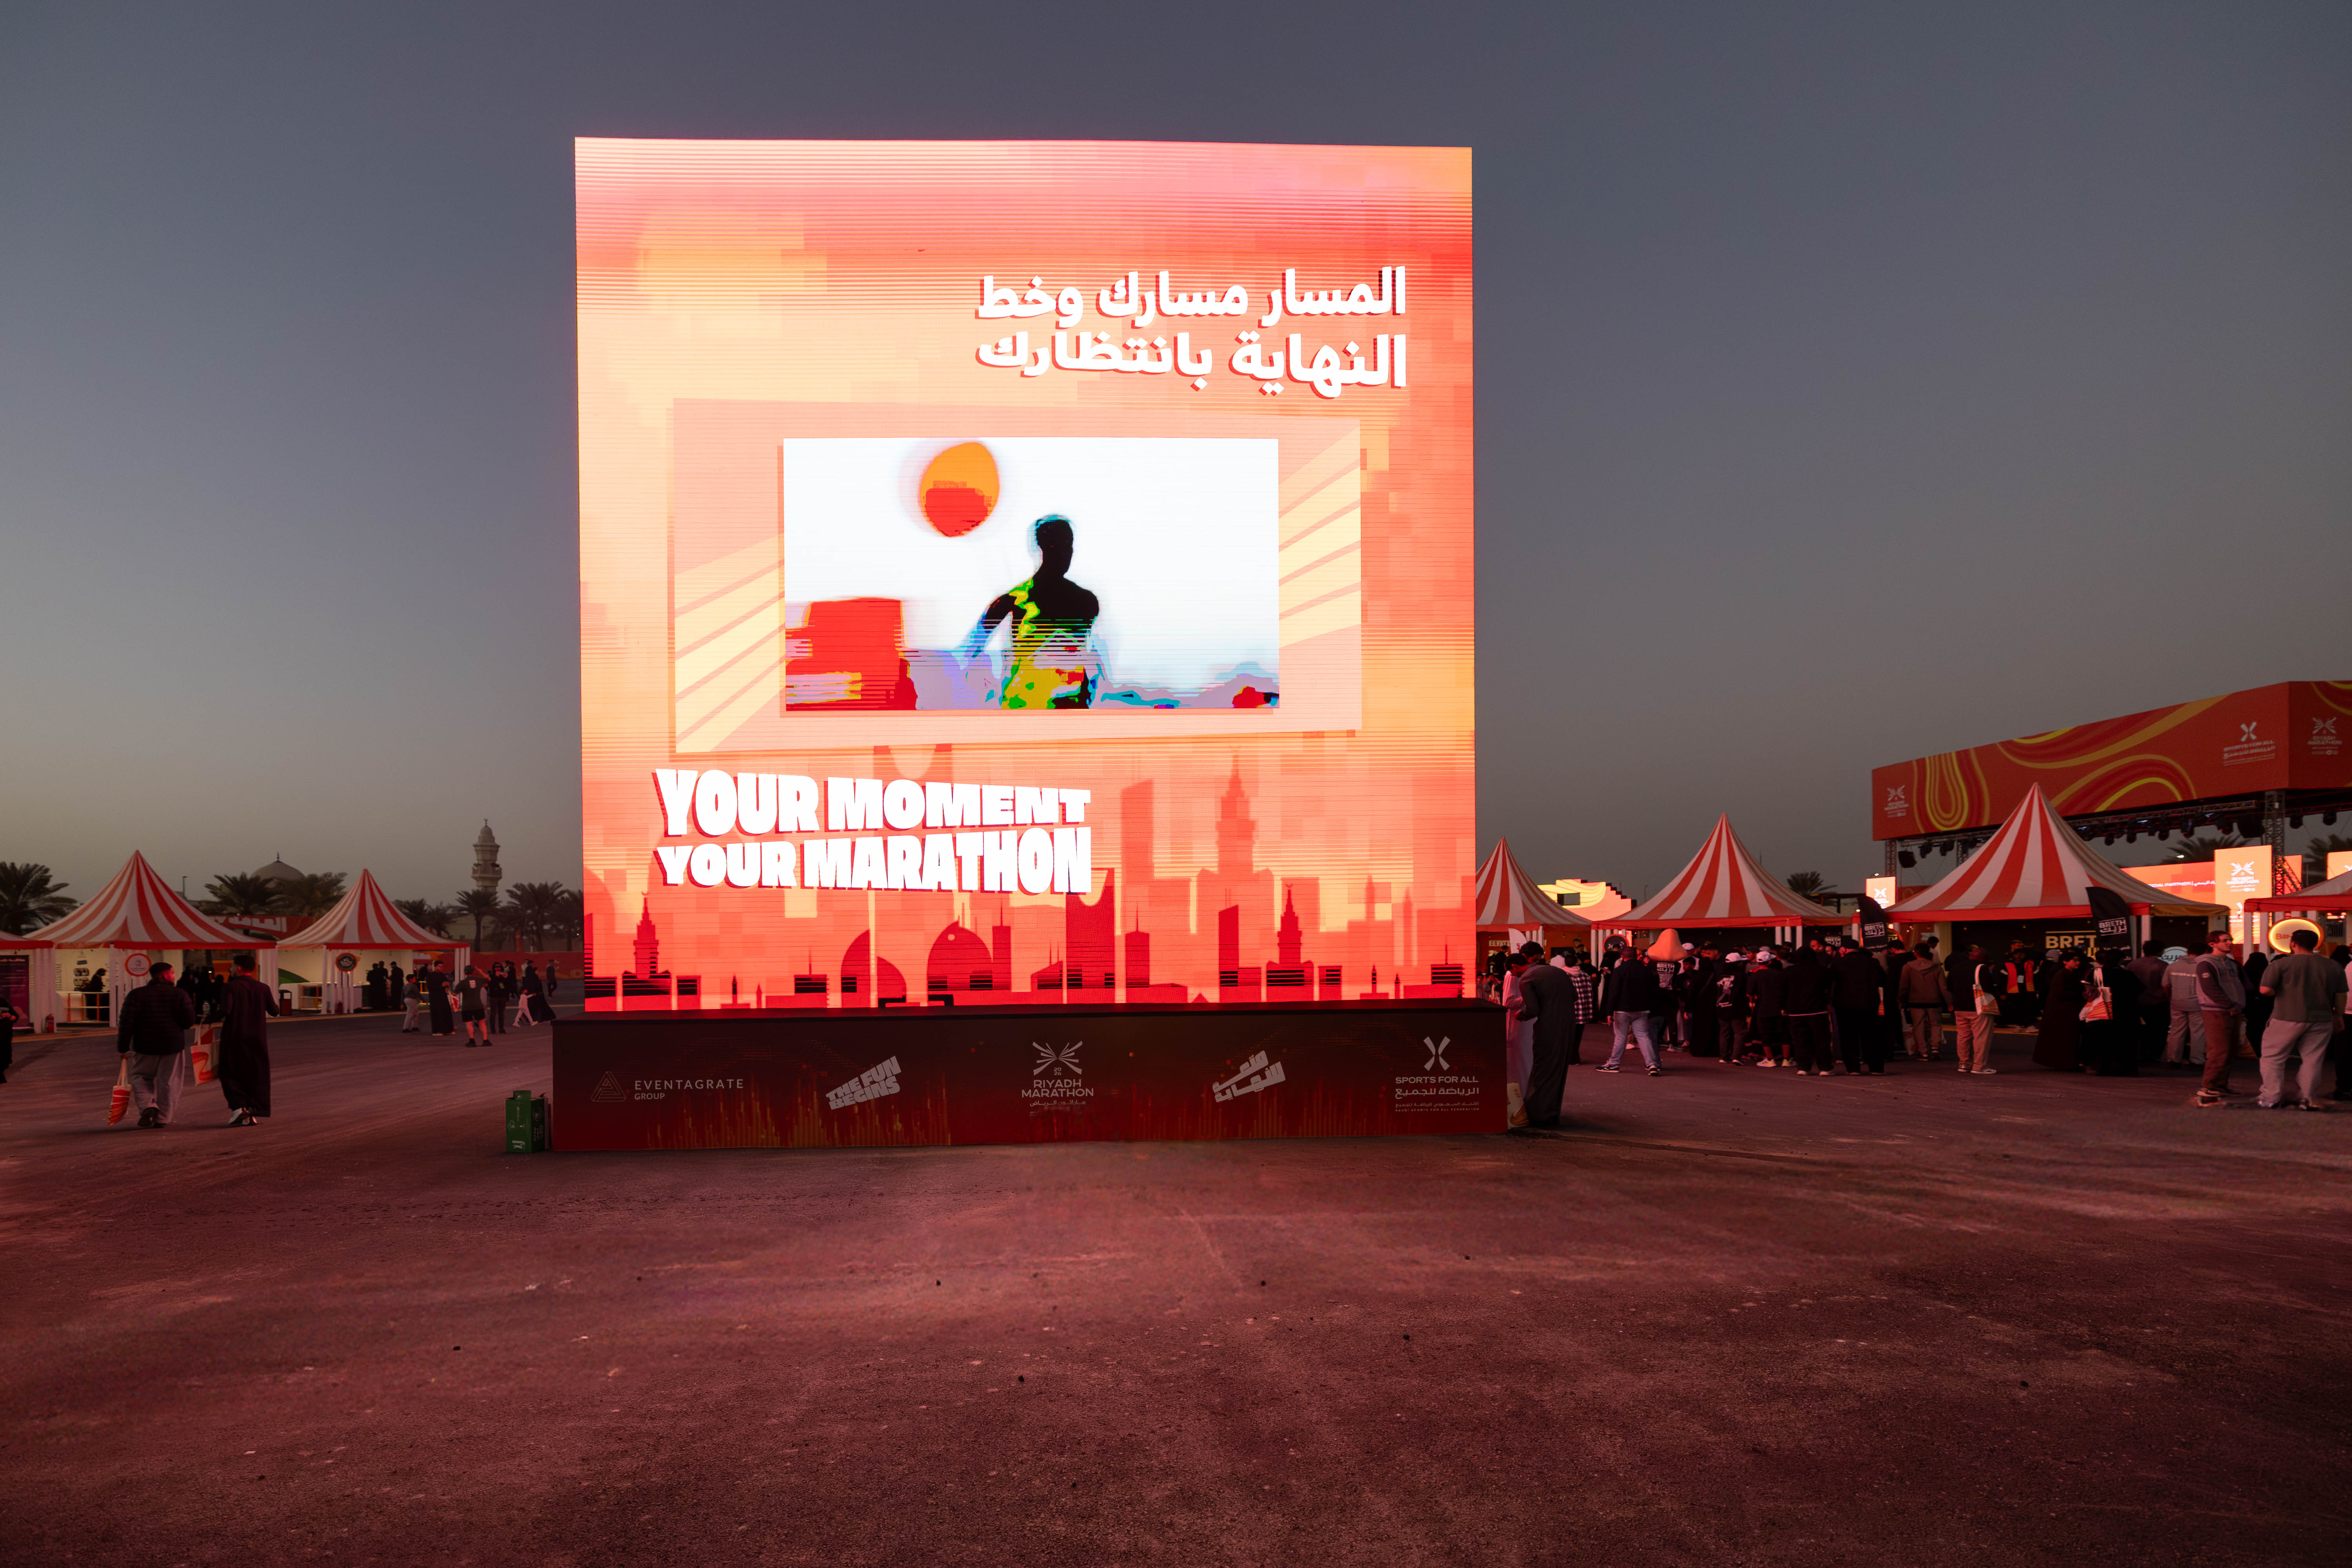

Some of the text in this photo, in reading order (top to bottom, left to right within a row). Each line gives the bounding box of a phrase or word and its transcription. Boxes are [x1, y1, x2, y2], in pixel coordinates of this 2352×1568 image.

[975, 266, 1406, 328] المسار مسارك وخط
[976, 330, 1407, 398] النهاية بانتظارك
[654, 768, 1091, 837] YOUR MOMENT
[656, 827, 1091, 895] YOUR MARATHON
[2098, 919, 2126, 928] BRETH
[2045, 935, 2097, 949] BRET
[635, 1079, 744, 1090] EVENTAGRATE
[826, 1056, 901, 1101] THE FUN
[1034, 1079, 1082, 1088] RIYADH
[829, 1076, 900, 1110] BEGINS
[1022, 1088, 1094, 1098] MARATHON
[1395, 1087, 1479, 1100] الرياضة للجميع
